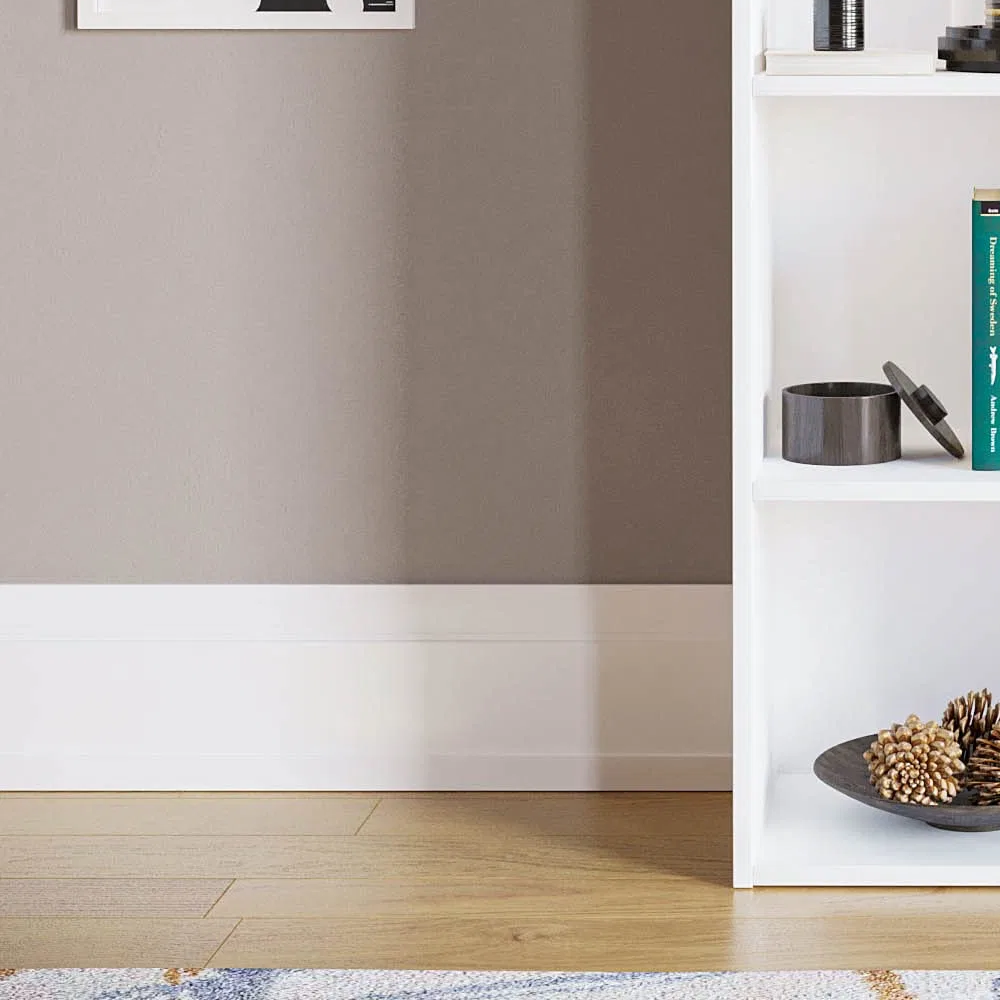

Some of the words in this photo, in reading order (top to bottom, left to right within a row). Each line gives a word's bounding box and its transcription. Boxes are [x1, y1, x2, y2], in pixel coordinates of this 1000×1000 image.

[987, 236, 998, 285] Dreaming
[989, 286, 998, 297] of
[989, 298, 998, 337] Sweden
[990, 394, 998, 425] Andrew
[990, 427, 998, 453] Brown
